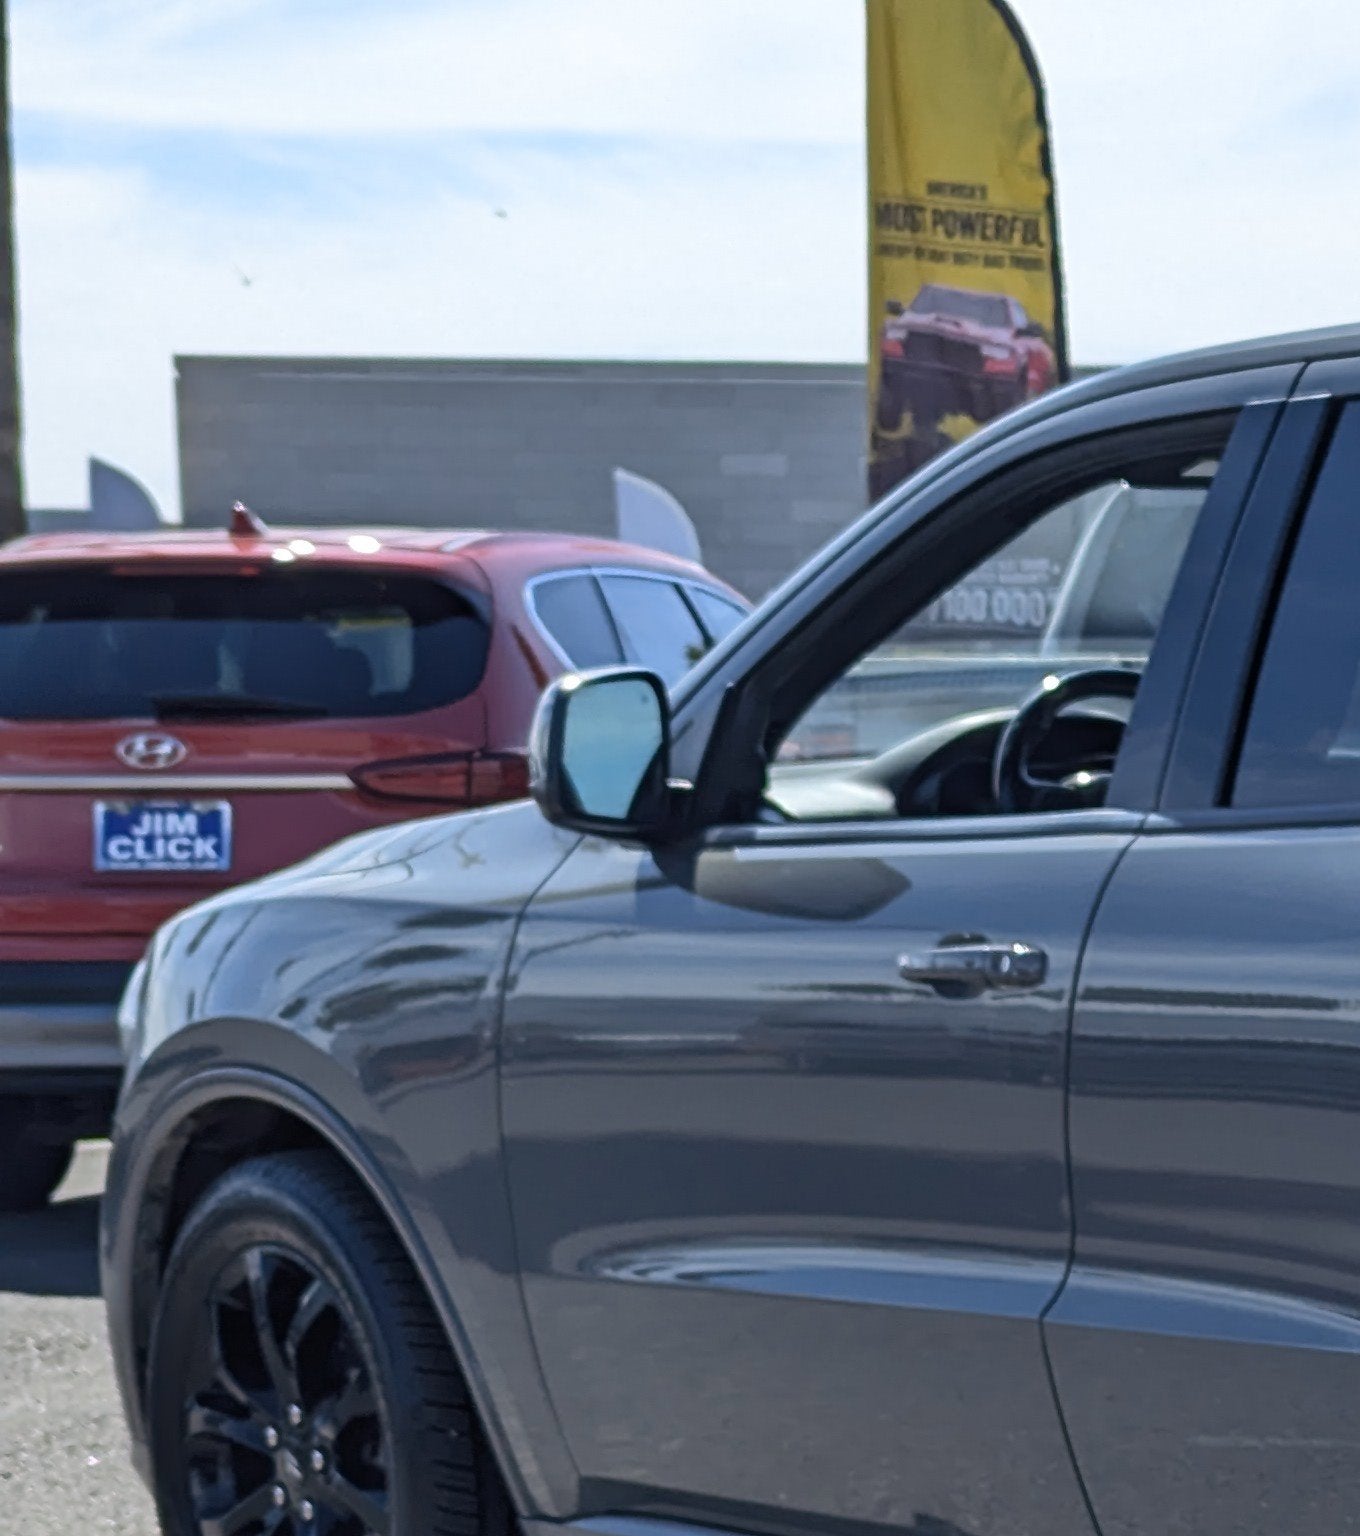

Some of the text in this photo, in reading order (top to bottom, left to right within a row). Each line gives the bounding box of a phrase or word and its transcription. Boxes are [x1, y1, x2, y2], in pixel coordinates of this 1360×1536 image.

[931, 208, 1044, 248] POWERFUL
[130, 811, 198, 835] JIM
[107, 835, 219, 861] CLICK
